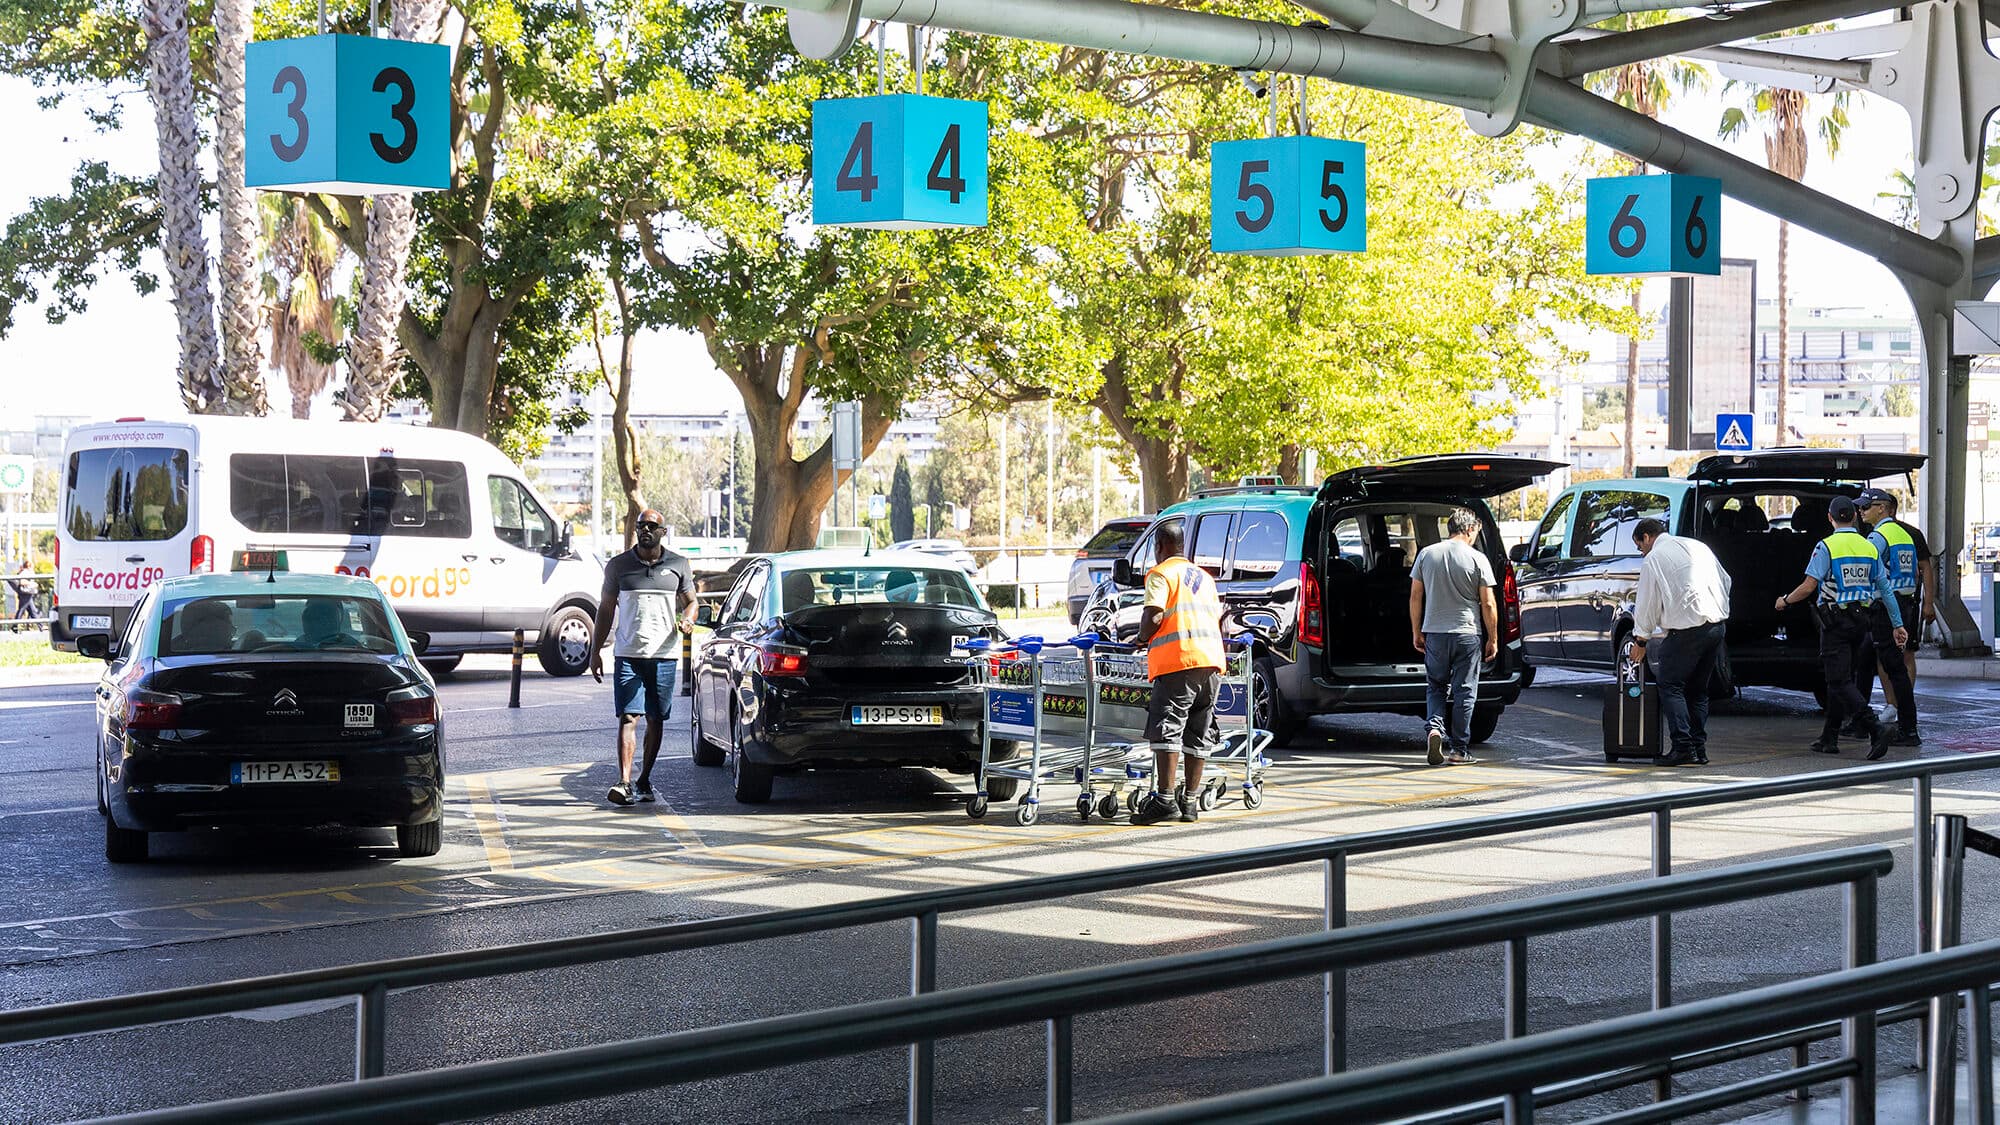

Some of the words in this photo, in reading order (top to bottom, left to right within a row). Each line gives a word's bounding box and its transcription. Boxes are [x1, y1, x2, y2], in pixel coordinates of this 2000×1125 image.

[270, 66, 309, 162] 3
[369, 67, 418, 163] 3
[836, 121, 878, 202] 4
[927, 124, 965, 204] 4
[1235, 160, 1274, 233] 5
[1319, 160, 1348, 232] 5
[1609, 194, 1646, 258] 6
[1685, 195, 1707, 259] 6
[93, 431, 164, 442] www.recordgo.com
[252, 552, 277, 564] TAXI
[346, 705, 373, 717] 1890
